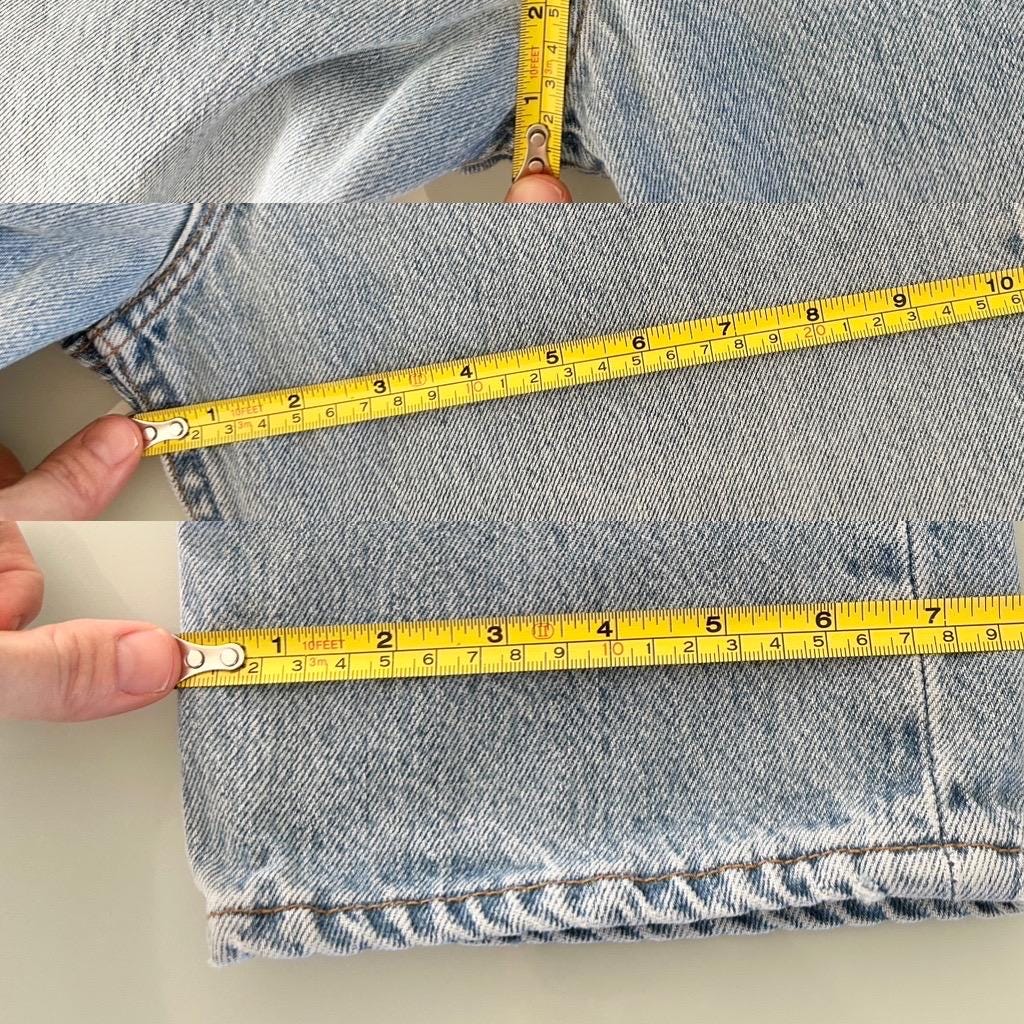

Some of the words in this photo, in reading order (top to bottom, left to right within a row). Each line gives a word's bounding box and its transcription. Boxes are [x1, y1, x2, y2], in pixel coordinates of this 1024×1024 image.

[528, 5, 543, 19] 2
[530, 46, 540, 80] 10FEET
[524, 96, 538, 104] 1
[207, 408, 216, 421] 1
[288, 394, 301, 409] 2
[374, 379, 387, 394] 3
[460, 365, 473, 378] 4
[546, 351, 559, 364] 5
[632, 336, 646, 350] 6
[718, 321, 731, 336] 7
[806, 308, 820, 322] 8
[893, 294, 906, 308] 9
[986, 276, 1014, 293] 10
[258, 418, 267, 428] 4
[292, 414, 301, 424] 5
[326, 407, 335, 418] 6
[360, 402, 368, 412] 7
[394, 396, 402, 407] 8
[428, 390, 437, 400] 9
[466, 381, 483, 394] 10
[530, 373, 539, 384] 2
[564, 367, 573, 377] 3
[598, 361, 607, 372] 4
[632, 355, 641, 366] 5
[666, 350, 675, 360] 6
[700, 344, 709, 355] 7
[734, 339, 744, 349] 8
[768, 333, 778, 344] 9
[804, 324, 826, 338] 20
[872, 317, 882, 327] 2
[908, 311, 917, 322] 3
[941, 305, 951, 316] 4
[977, 300, 986, 310] 5
[1011, 294, 1021, 304] 6
[248, 662, 258, 674] 2
[292, 660, 303, 672] 3
[335, 658, 346, 669] 4
[380, 656, 390, 667] 5
[423, 653, 434, 665] 6
[467, 651, 478, 663] 7
[510, 649, 521, 661] 8
[554, 647, 565, 658] 9
[603, 643, 624, 656] 10
[684, 641, 694, 653] 2
[727, 639, 738, 651] 3
[770, 637, 781, 649] 4
[814, 636, 824, 647] 5
[857, 634, 868, 646] 6
[899, 632, 910, 644] 7
[943, 630, 954, 642] 8
[986, 628, 997, 640] 9
[272, 636, 281, 653] 1
[302, 640, 346, 650] 10FEET
[376, 631, 393, 649] 2
[487, 626, 503, 643] 3
[597, 621, 613, 638] 4
[706, 616, 722, 633] 5
[815, 611, 832, 629] 6
[925, 607, 941, 624] 7
